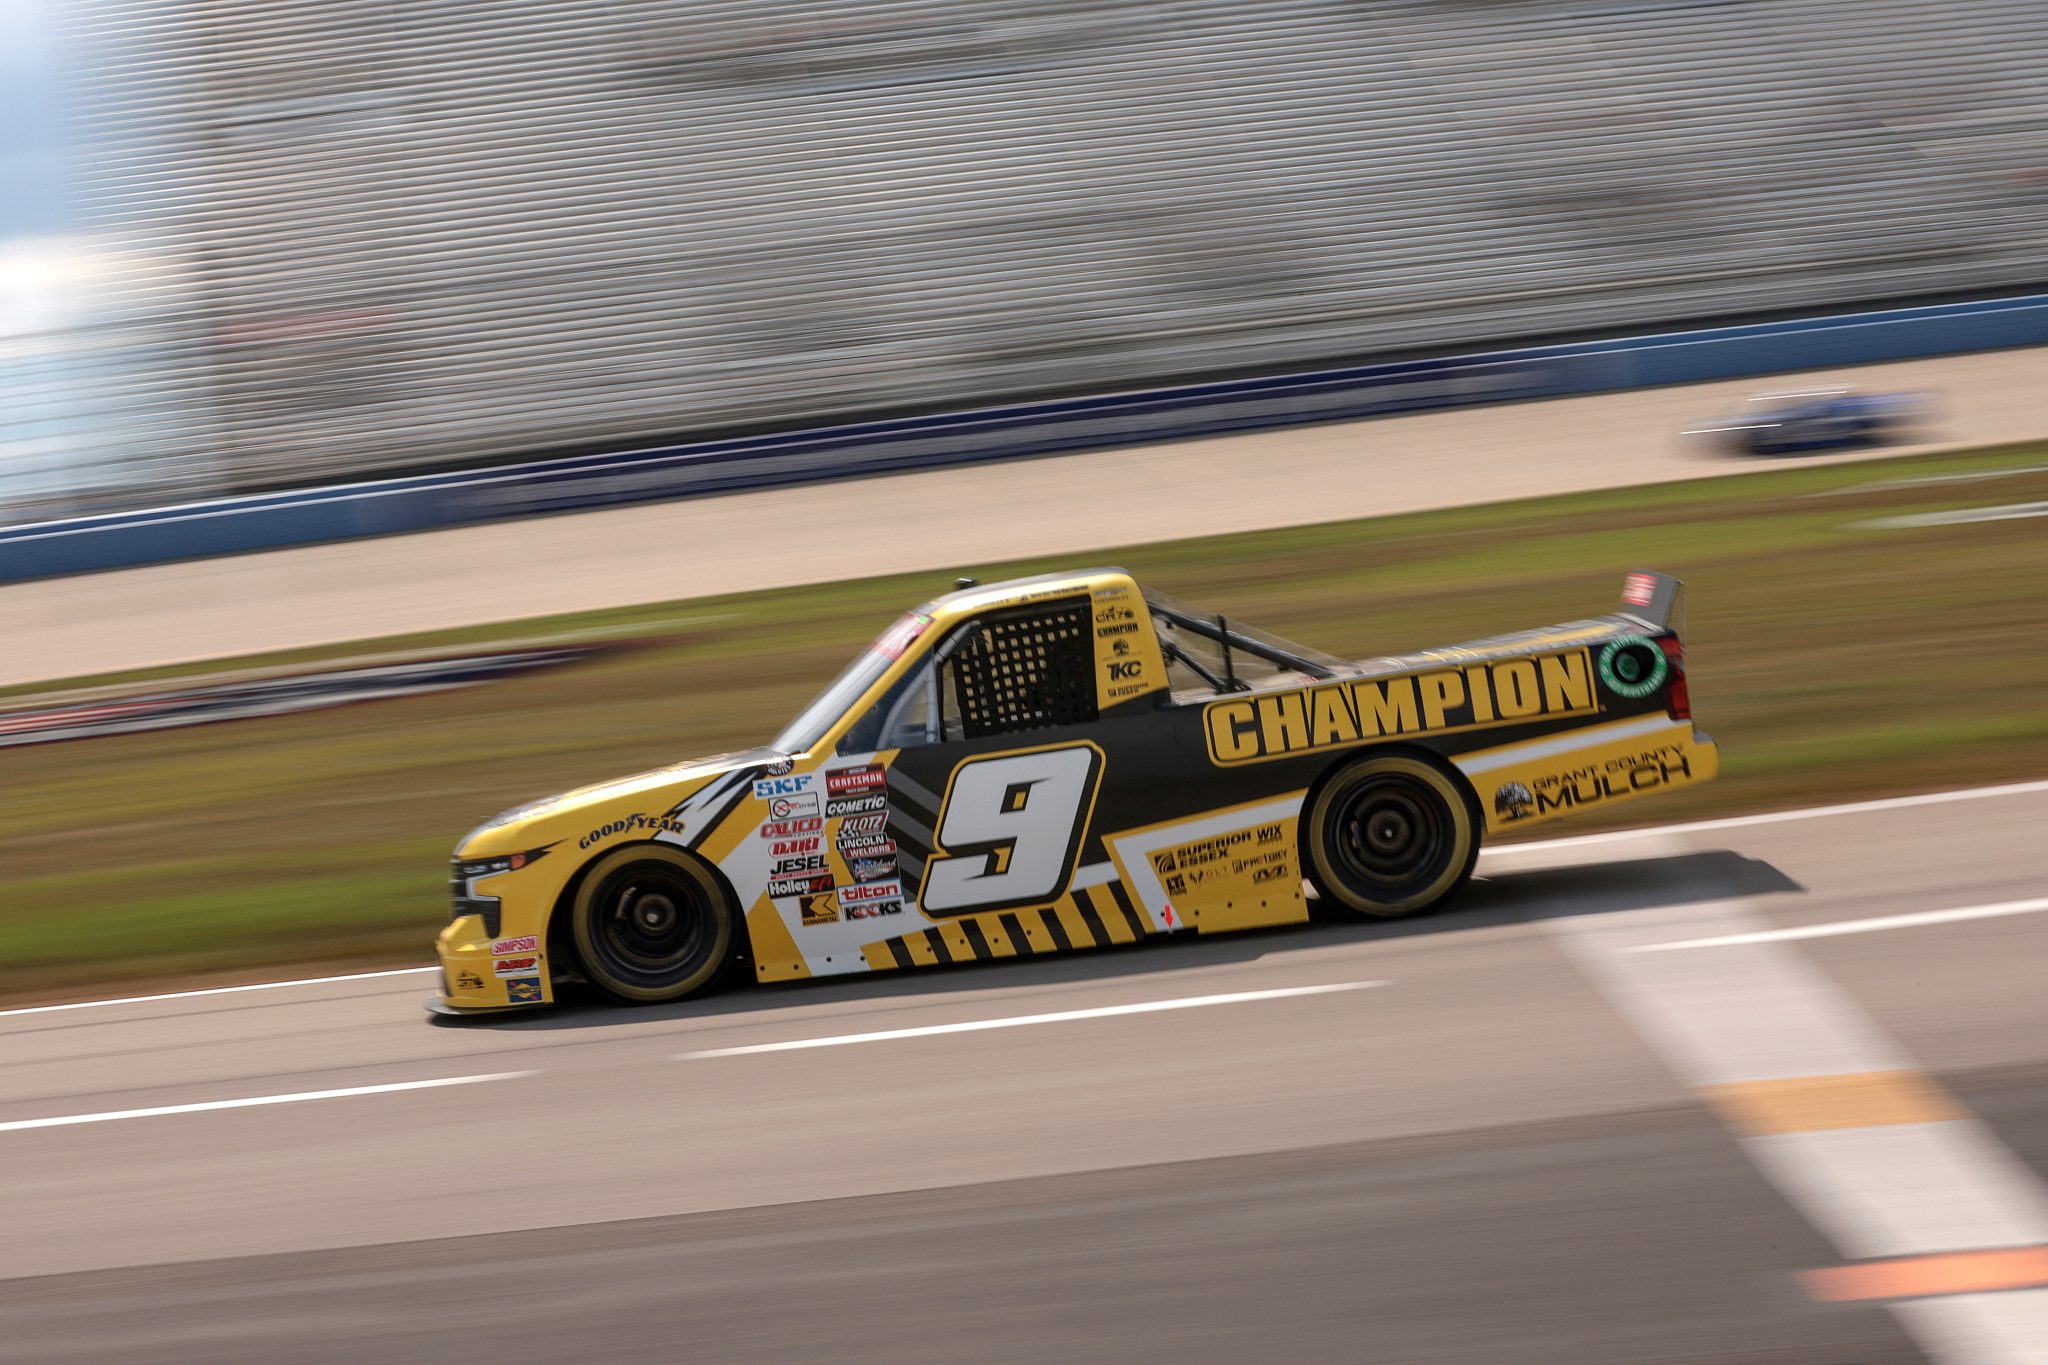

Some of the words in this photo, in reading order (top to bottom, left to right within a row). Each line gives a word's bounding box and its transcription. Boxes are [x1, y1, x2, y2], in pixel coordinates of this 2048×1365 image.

[1097, 622, 1139, 637] CHAMPION
[1107, 661, 1142, 681] TKC
[1208, 649, 1591, 762] CHAMPION
[1533, 764, 1599, 790] GRANT
[1605, 743, 1684, 773] COUNTY
[756, 776, 812, 797] SKF
[830, 772, 883, 788] CRAFTSMAN
[1535, 755, 1692, 814] MULCH
[827, 794, 885, 816] COMETIC
[579, 814, 685, 849] GOODYEAR
[761, 817, 824, 838] CALICO
[843, 815, 884, 832] KLOTZ
[921, 743, 1100, 914] 9
[1257, 825, 1282, 840] WIX
[838, 833, 885, 849] LINCOLN
[850, 844, 890, 857] WELDERS
[1177, 832, 1252, 857] SUPERIOR
[770, 855, 829, 874] JESEL
[1180, 848, 1228, 869] ESSEX
[770, 879, 809, 895] Holley
[842, 884, 899, 901] tilton
[802, 916, 838, 926] KENNAMETAL
[494, 937, 536, 954] SIMPSON
